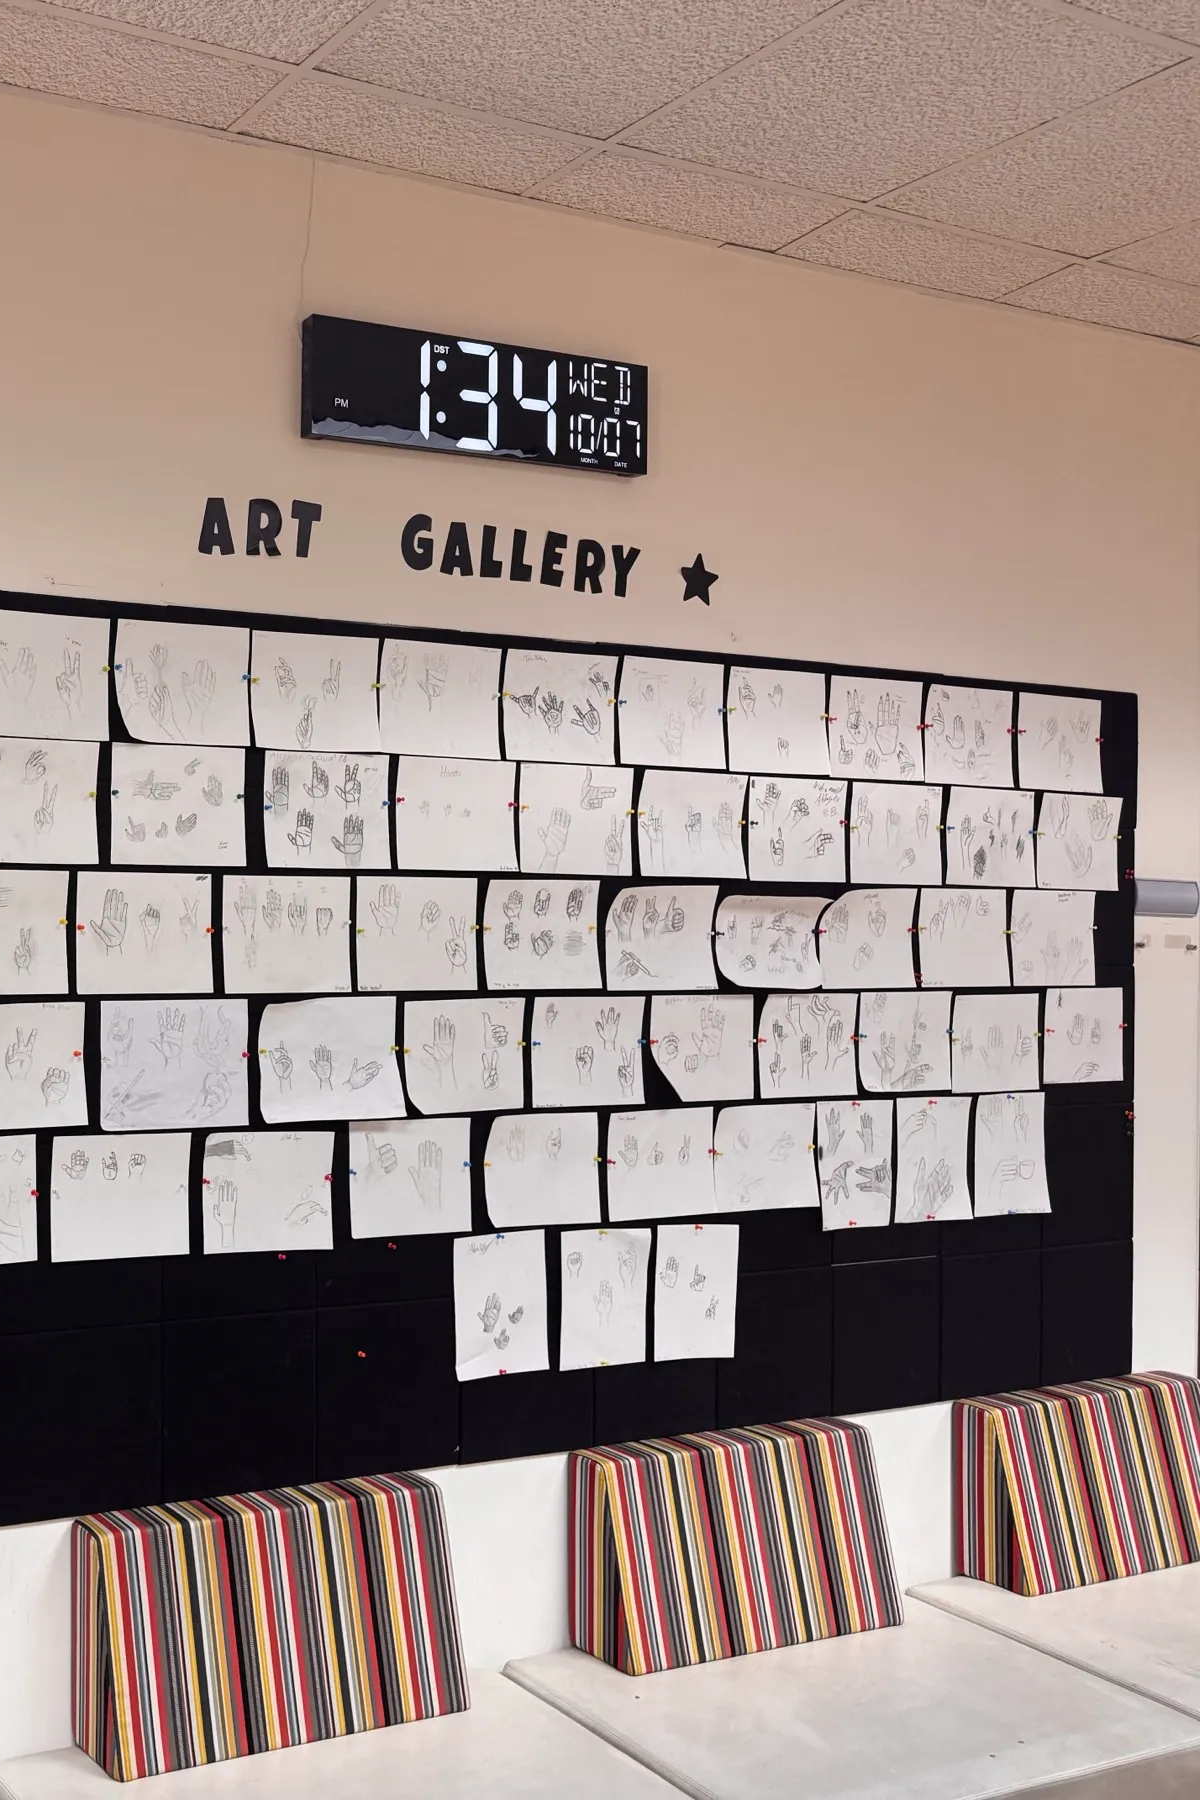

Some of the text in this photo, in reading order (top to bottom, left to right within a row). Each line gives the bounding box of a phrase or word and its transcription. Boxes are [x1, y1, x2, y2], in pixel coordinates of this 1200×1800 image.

[433, 344, 450, 355] DST
[334, 397, 349, 408] PM
[419, 339, 557, 456] 1:34
[568, 360, 631, 405] WED
[569, 413, 641, 459] 10/07
[580, 456, 628, 469] MONTH DATE
[197, 497, 641, 598] ART GALLERY
